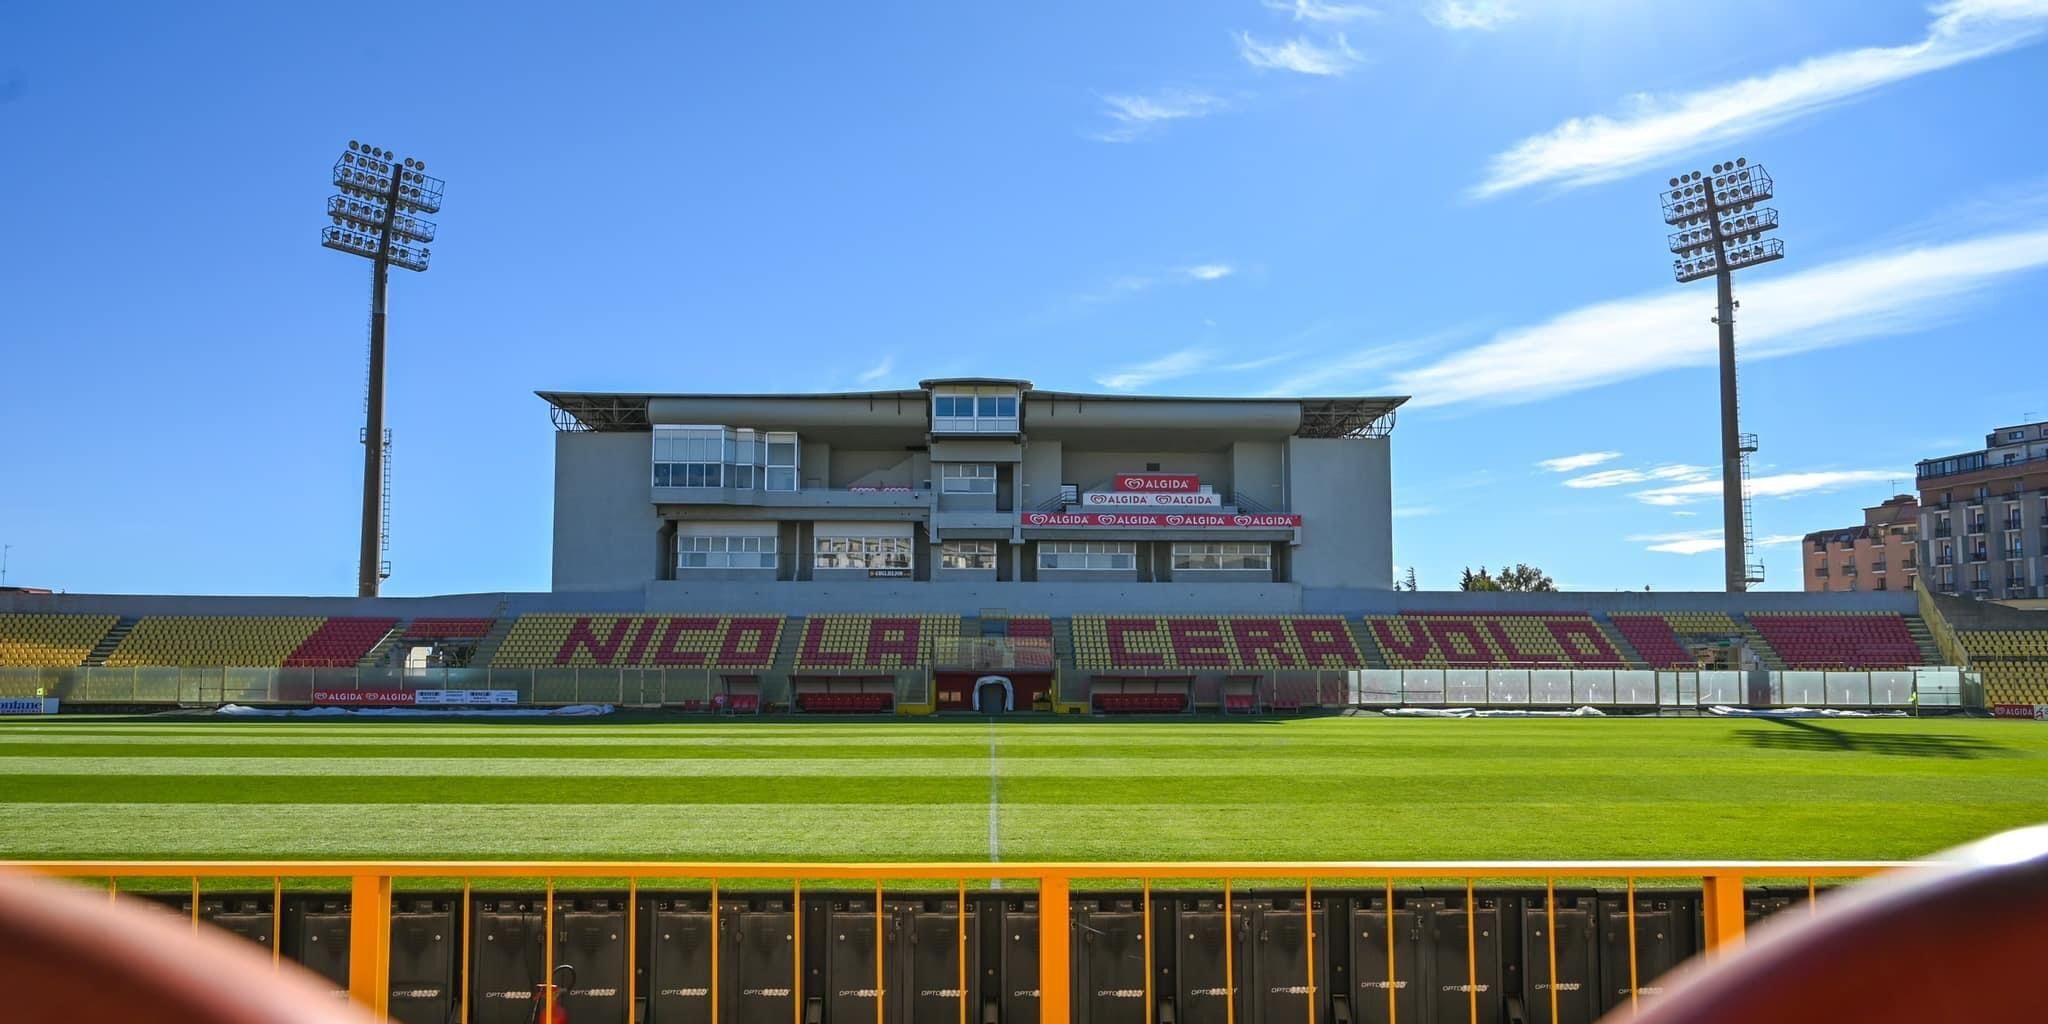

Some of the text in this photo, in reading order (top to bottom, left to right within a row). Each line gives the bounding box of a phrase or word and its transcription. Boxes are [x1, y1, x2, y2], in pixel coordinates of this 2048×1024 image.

[1145, 479, 1188, 489] ALGIDA
[1107, 495, 1212, 505] ALGIDA ALGIDA
[1049, 515, 1292, 525] ALGIDA ALGIDA ALGIDA ALGIDA
[328, 692, 362, 701] ALGIDA
[380, 692, 414, 701] ALGIDA
[2006, 708, 2033, 716] ALGIDA
